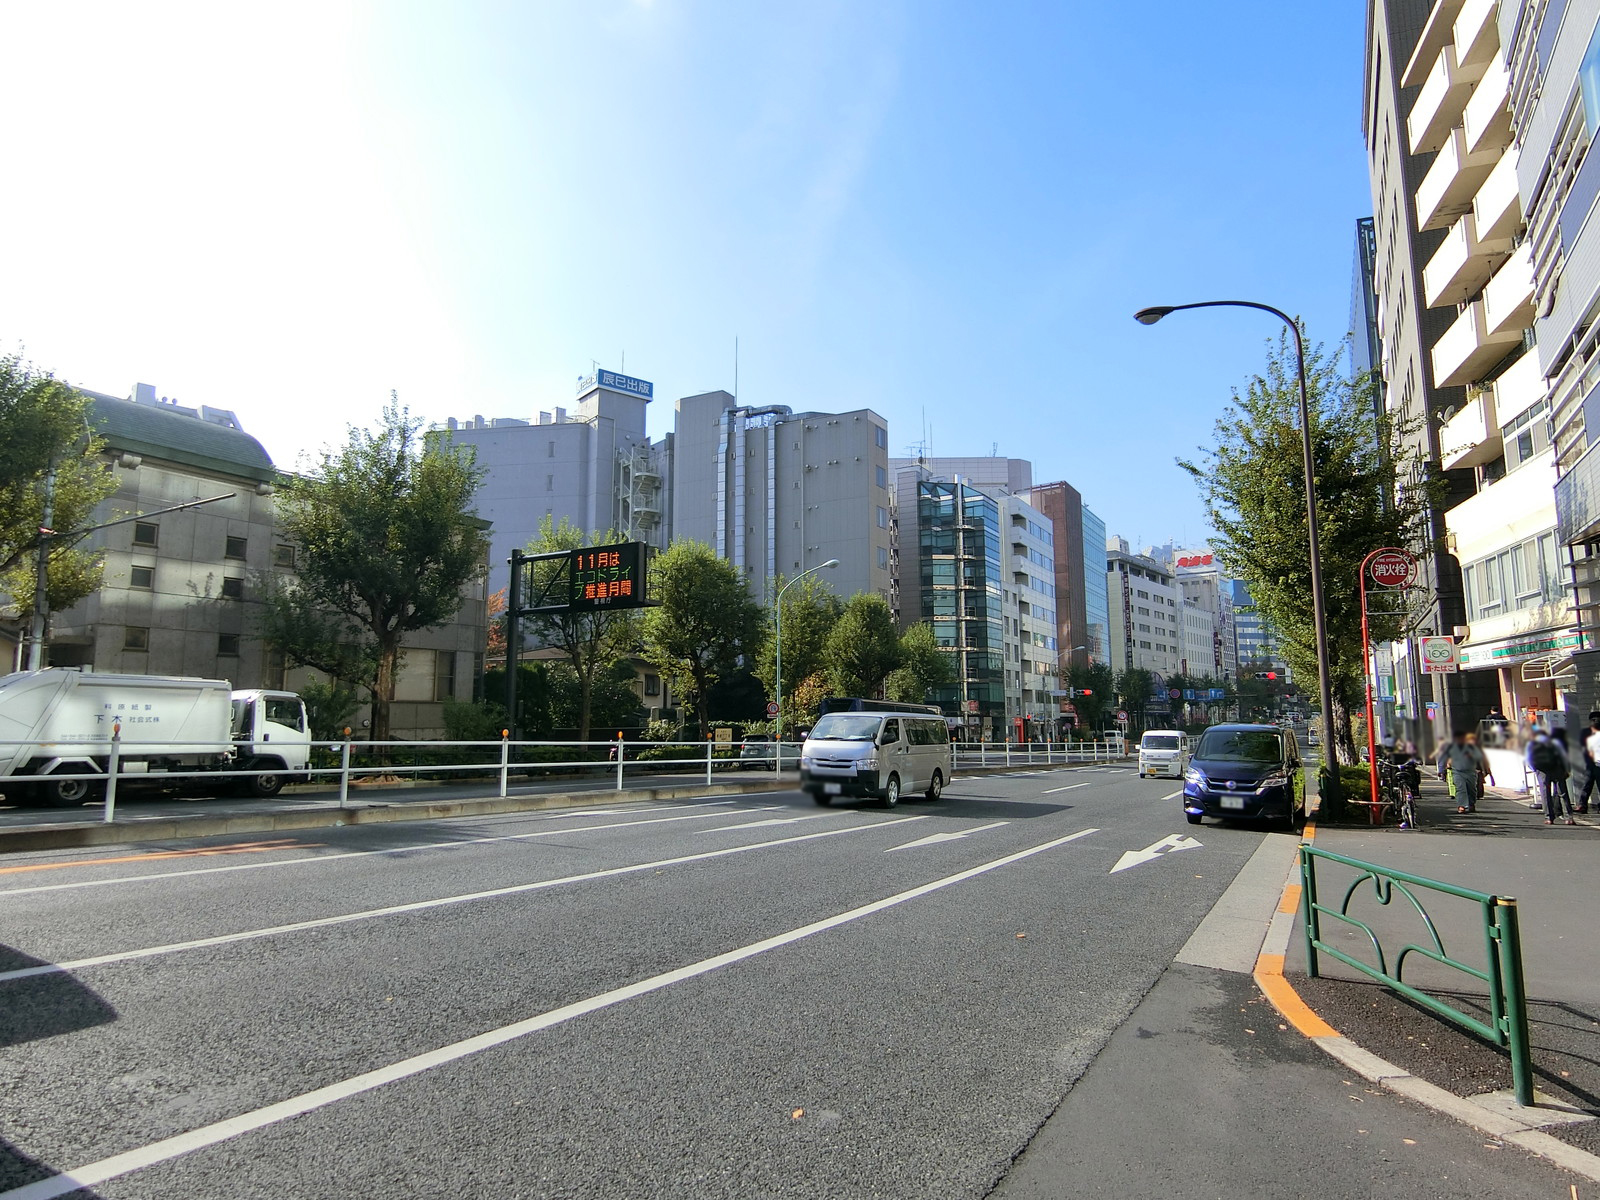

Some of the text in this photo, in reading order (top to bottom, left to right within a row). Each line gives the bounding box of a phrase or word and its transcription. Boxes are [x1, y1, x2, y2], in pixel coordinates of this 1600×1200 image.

[602, 372, 650, 394] 辰巳出版
[577, 552, 620, 570] 11月は
[575, 566, 632, 583] エコドライ
[1374, 563, 1407, 577] 消火栓
[1427, 649, 1450, 659] 100
